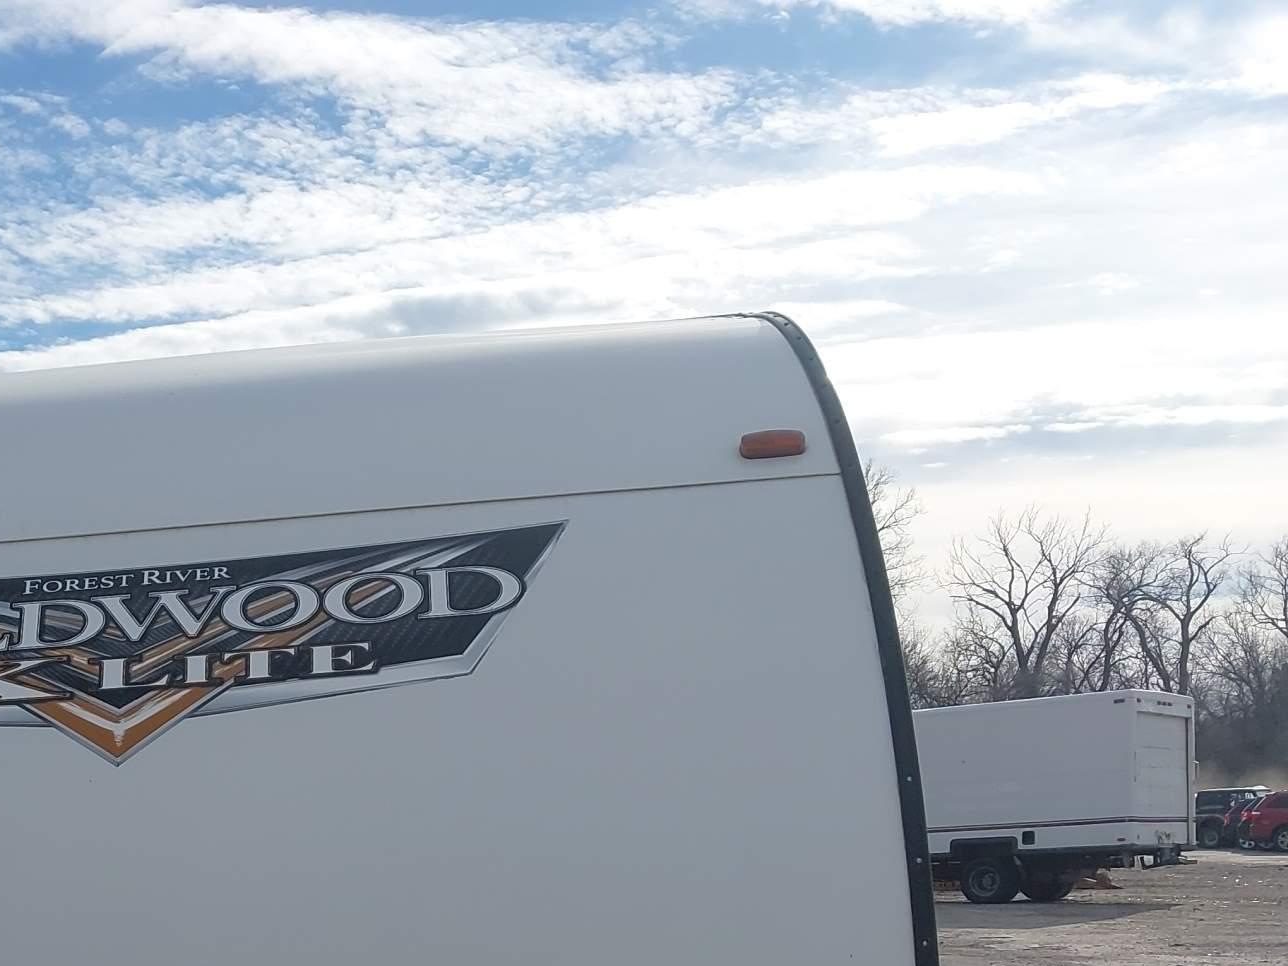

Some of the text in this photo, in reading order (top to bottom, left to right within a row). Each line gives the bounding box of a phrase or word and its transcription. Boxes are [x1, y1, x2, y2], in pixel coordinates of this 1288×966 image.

[23, 566, 232, 595] FOREST RIVER
[88, 640, 381, 691] LITE
